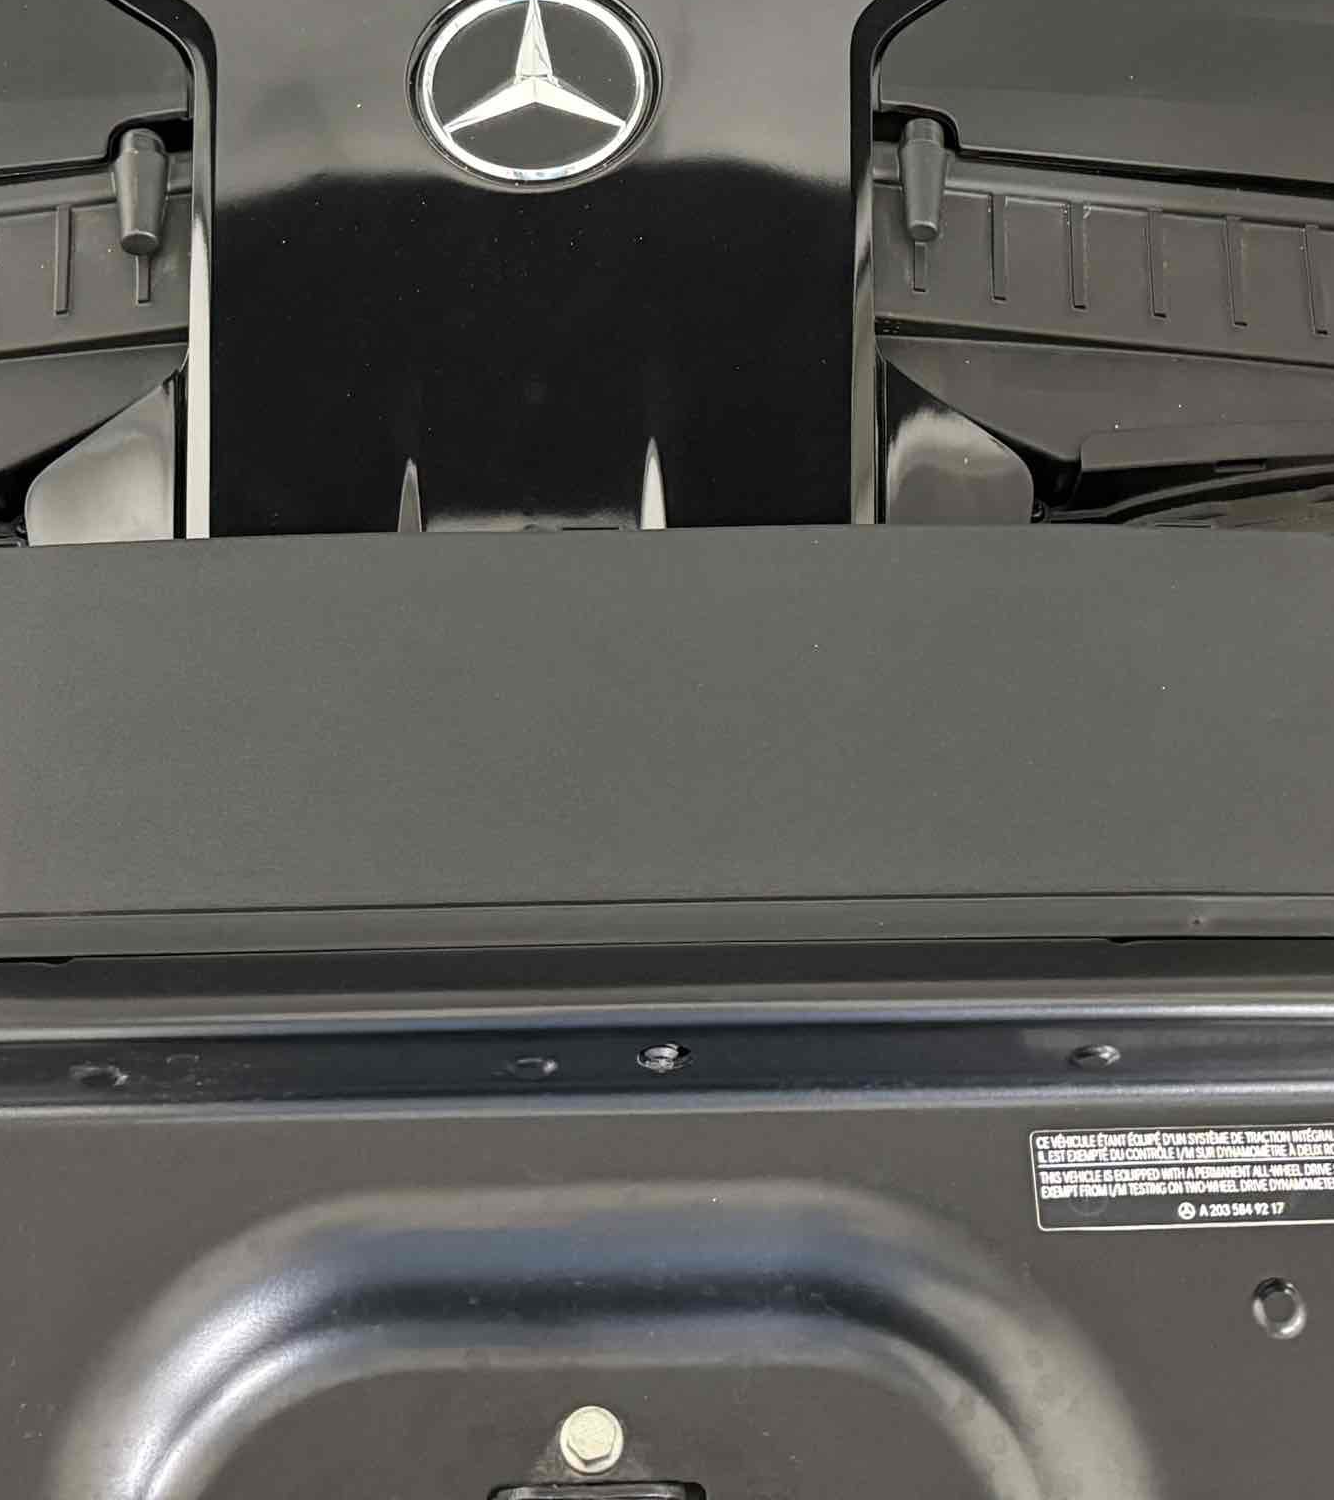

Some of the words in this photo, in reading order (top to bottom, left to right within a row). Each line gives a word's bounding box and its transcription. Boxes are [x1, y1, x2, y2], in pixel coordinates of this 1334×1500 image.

[1036, 1136, 1049, 1149] CE
[1050, 1133, 1096, 1148] VÉHICULE
[1097, 1132, 1126, 1148] ÉTANT
[1127, 1130, 1161, 1147] ÉQUIPÉ
[1162, 1132, 1187, 1146] D'UN
[1231, 1132, 1244, 1144] DE
[1244, 1130, 1291, 1144] TRACTION
[1037, 1150, 1047, 1164] IL
[1047, 1150, 1065, 1162] EST
[1067, 1146, 1109, 1162] EXEMPTÉ
[1109, 1148, 1125, 1160] DU
[1125, 1144, 1175, 1160] CONTRÔLE
[1195, 1146, 1215, 1158] SUR
[1297, 1143, 1323, 1156] DEUX
[1039, 1171, 1061, 1184] THIS
[1062, 1170, 1102, 1184] VEHICLE
[1103, 1170, 1113, 1182] IS
[1113, 1168, 1161, 1182] EQUIPPED
[1161, 1167, 1185, 1180] WITH
[1187, 1166, 1194, 1179] A
[1194, 1164, 1251, 1179] PERMANENT
[1252, 1163, 1303, 1178] ALL-WHEEL
[1303, 1162, 1331, 1176] DRIVE
[1041, 1185, 1077, 1199] EXEMPT
[1079, 1184, 1107, 1198] FROM
[1128, 1182, 1167, 1196] TESTING
[1167, 1180, 1183, 1194] ON
[1183, 1179, 1239, 1193] TWO-WHEEL
[1239, 1178, 1268, 1192] DRIVE
[1199, 1204, 1209, 1217] A
[1209, 1203, 1231, 1217] 203
[1231, 1202, 1253, 1216] 584
[1254, 1202, 1269, 1216] 92
[1271, 1202, 1285, 1215] 17
